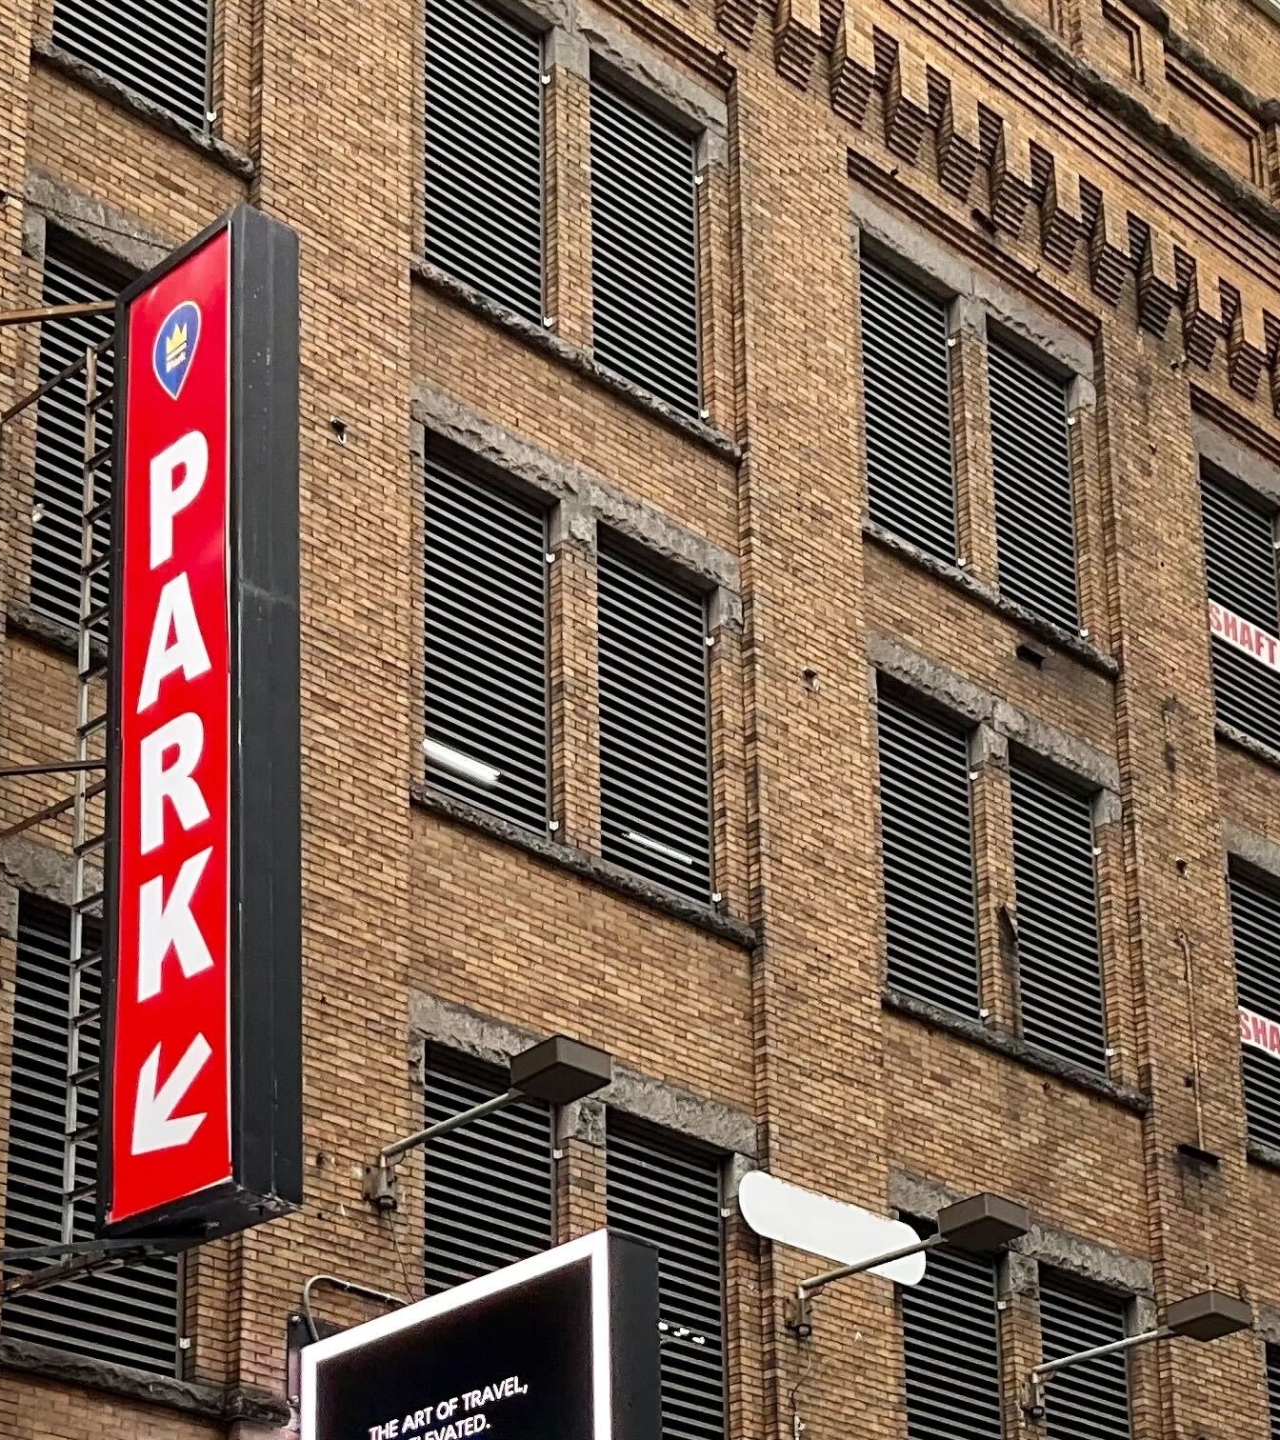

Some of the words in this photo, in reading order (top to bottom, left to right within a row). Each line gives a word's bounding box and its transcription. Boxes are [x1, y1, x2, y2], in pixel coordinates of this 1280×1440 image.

[1209, 600, 1277, 665] SHAFT
[136, 427, 215, 1004] PARK
[402, 1406, 434, 1433] ART
[436, 1398, 458, 1420] OF
[461, 1376, 528, 1411] TRAVEL,
